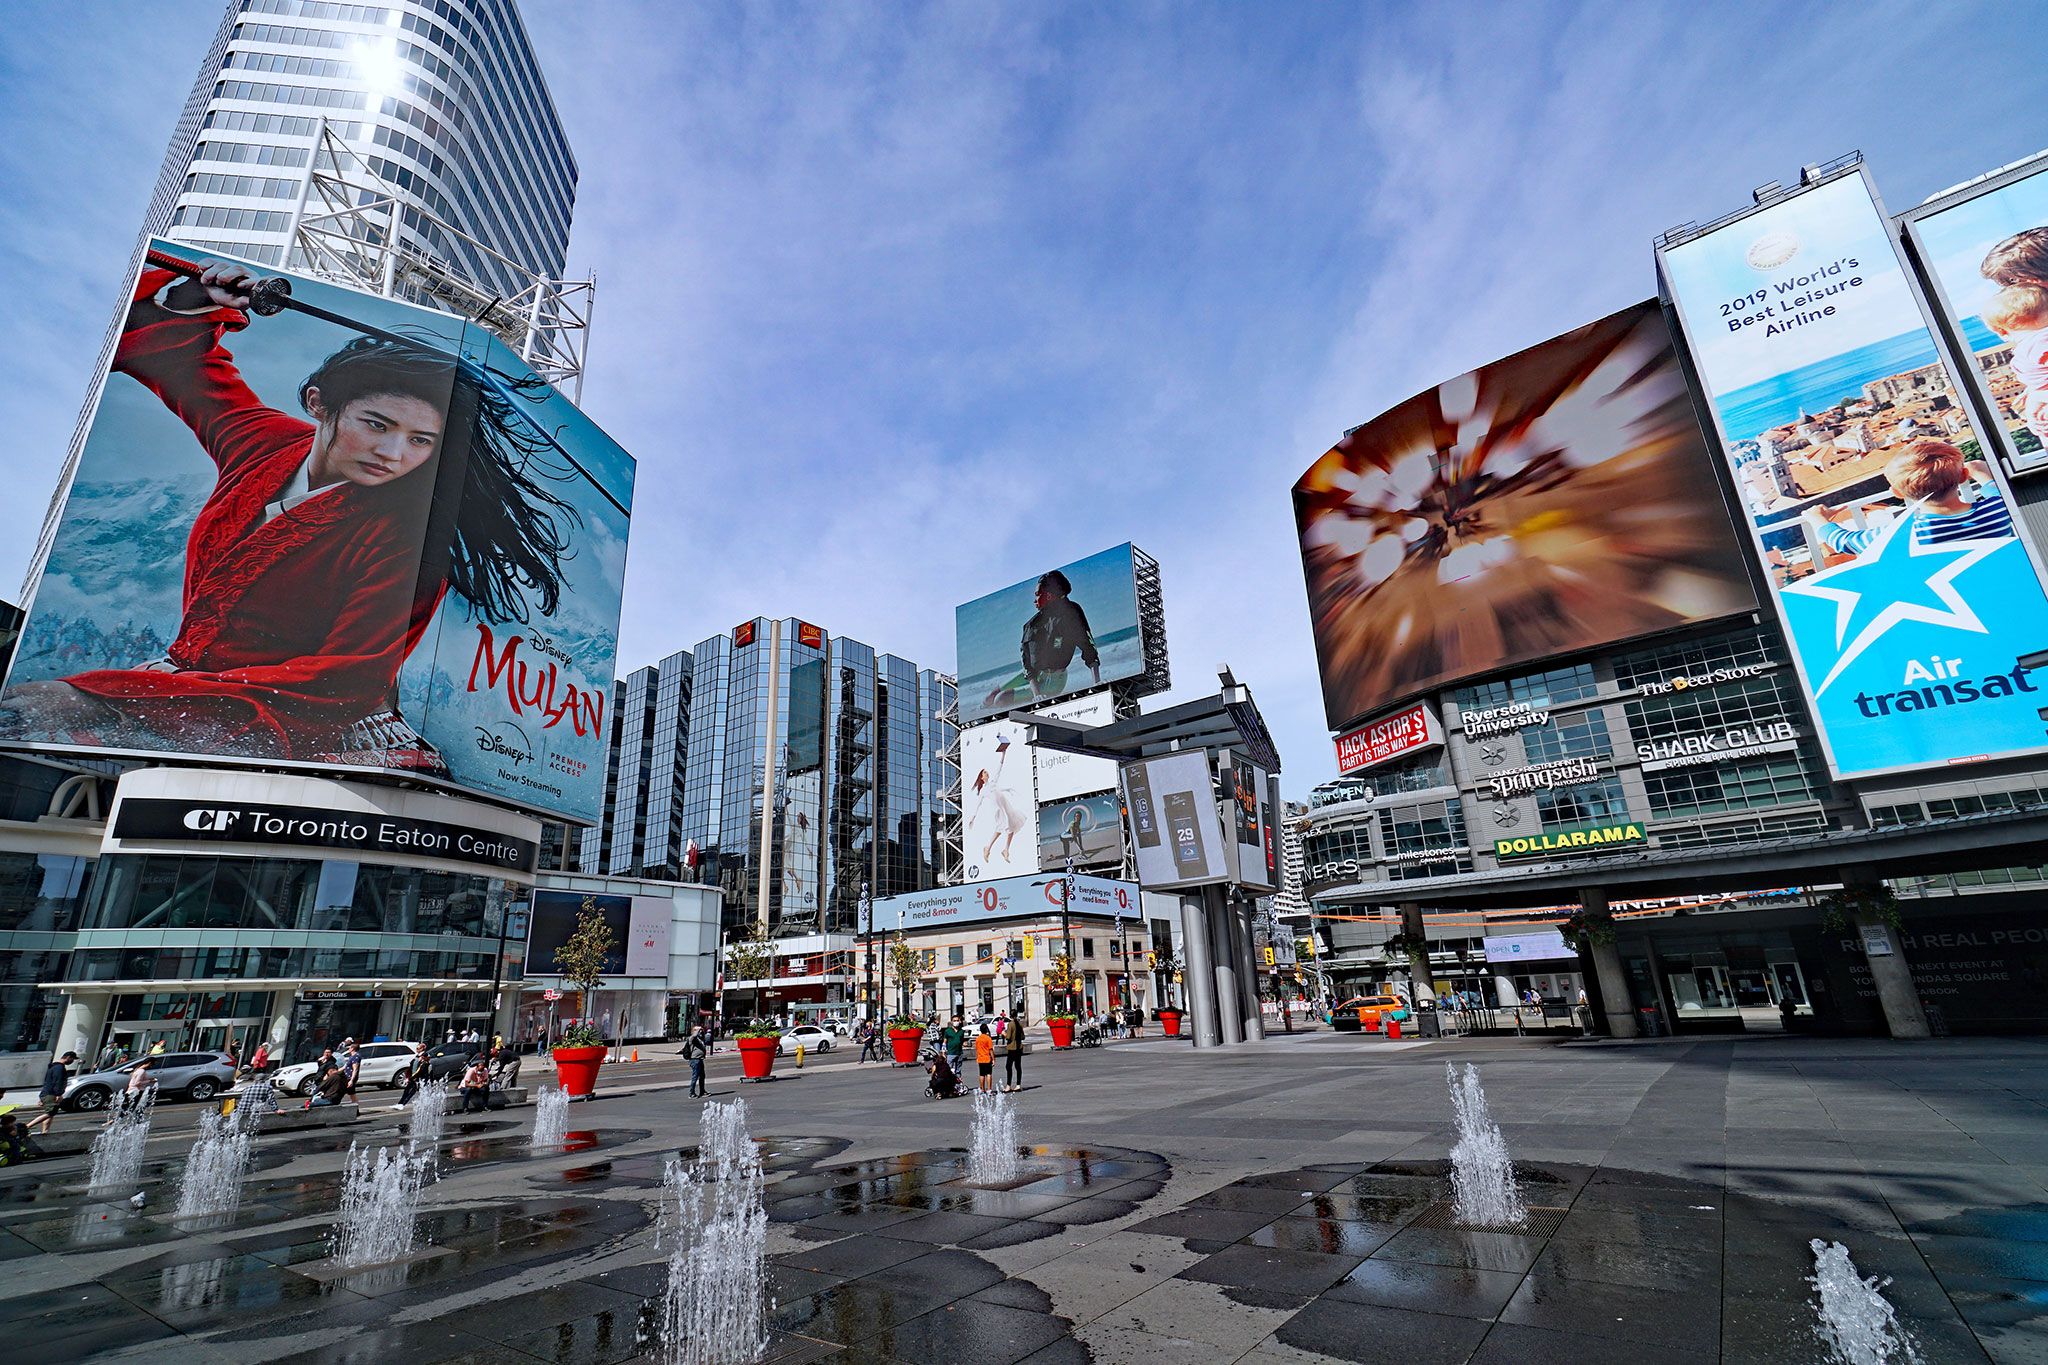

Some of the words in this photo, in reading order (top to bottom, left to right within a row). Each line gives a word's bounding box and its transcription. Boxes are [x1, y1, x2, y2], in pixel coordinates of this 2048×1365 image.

[1719, 289, 1768, 317] 2019
[1773, 258, 1860, 294] World's
[1728, 306, 1775, 332] Best
[1780, 276, 1863, 312] Leisure
[1766, 305, 1837, 338] Airline
[803, 625, 820, 637] CIBC
[1903, 655, 1962, 686] Air
[1853, 664, 2039, 718] transat
[1461, 702, 1531, 725] Ryerson
[1464, 711, 1550, 736] University
[1340, 732, 1370, 759] JACK
[1370, 710, 1424, 747] ASTOR'S
[1637, 733, 1720, 762] SHARK
[1725, 722, 1794, 749] CLUB
[550, 752, 588, 771] PREMIER
[1040, 755, 1071, 769] Lighter
[1342, 753, 1365, 770] PARTY
[1364, 749, 1373, 761] IS
[1373, 742, 1391, 759] THIS
[1391, 735, 1409, 752] WAY
[1665, 755, 1706, 769] SPORTS
[1711, 751, 1734, 762] BAR
[549, 763, 582, 778] ACCESS
[497, 768, 519, 784] Now
[520, 774, 562, 798] Streaming
[183, 809, 241, 831] CF
[249, 811, 368, 840] Toronto
[378, 822, 450, 850] Eaton
[457, 834, 518, 862] Centre
[1177, 828, 1194, 842] 29
[1498, 825, 1642, 855] DOLLARAMA
[1397, 847, 1455, 861] milestones
[907, 898, 947, 910] Everything
[948, 896, 963, 905] you
[1079, 886, 1102, 897] Everything
[912, 910, 931, 920] need
[932, 906, 958, 917] &more
[1921, 932, 1988, 949] REAL
